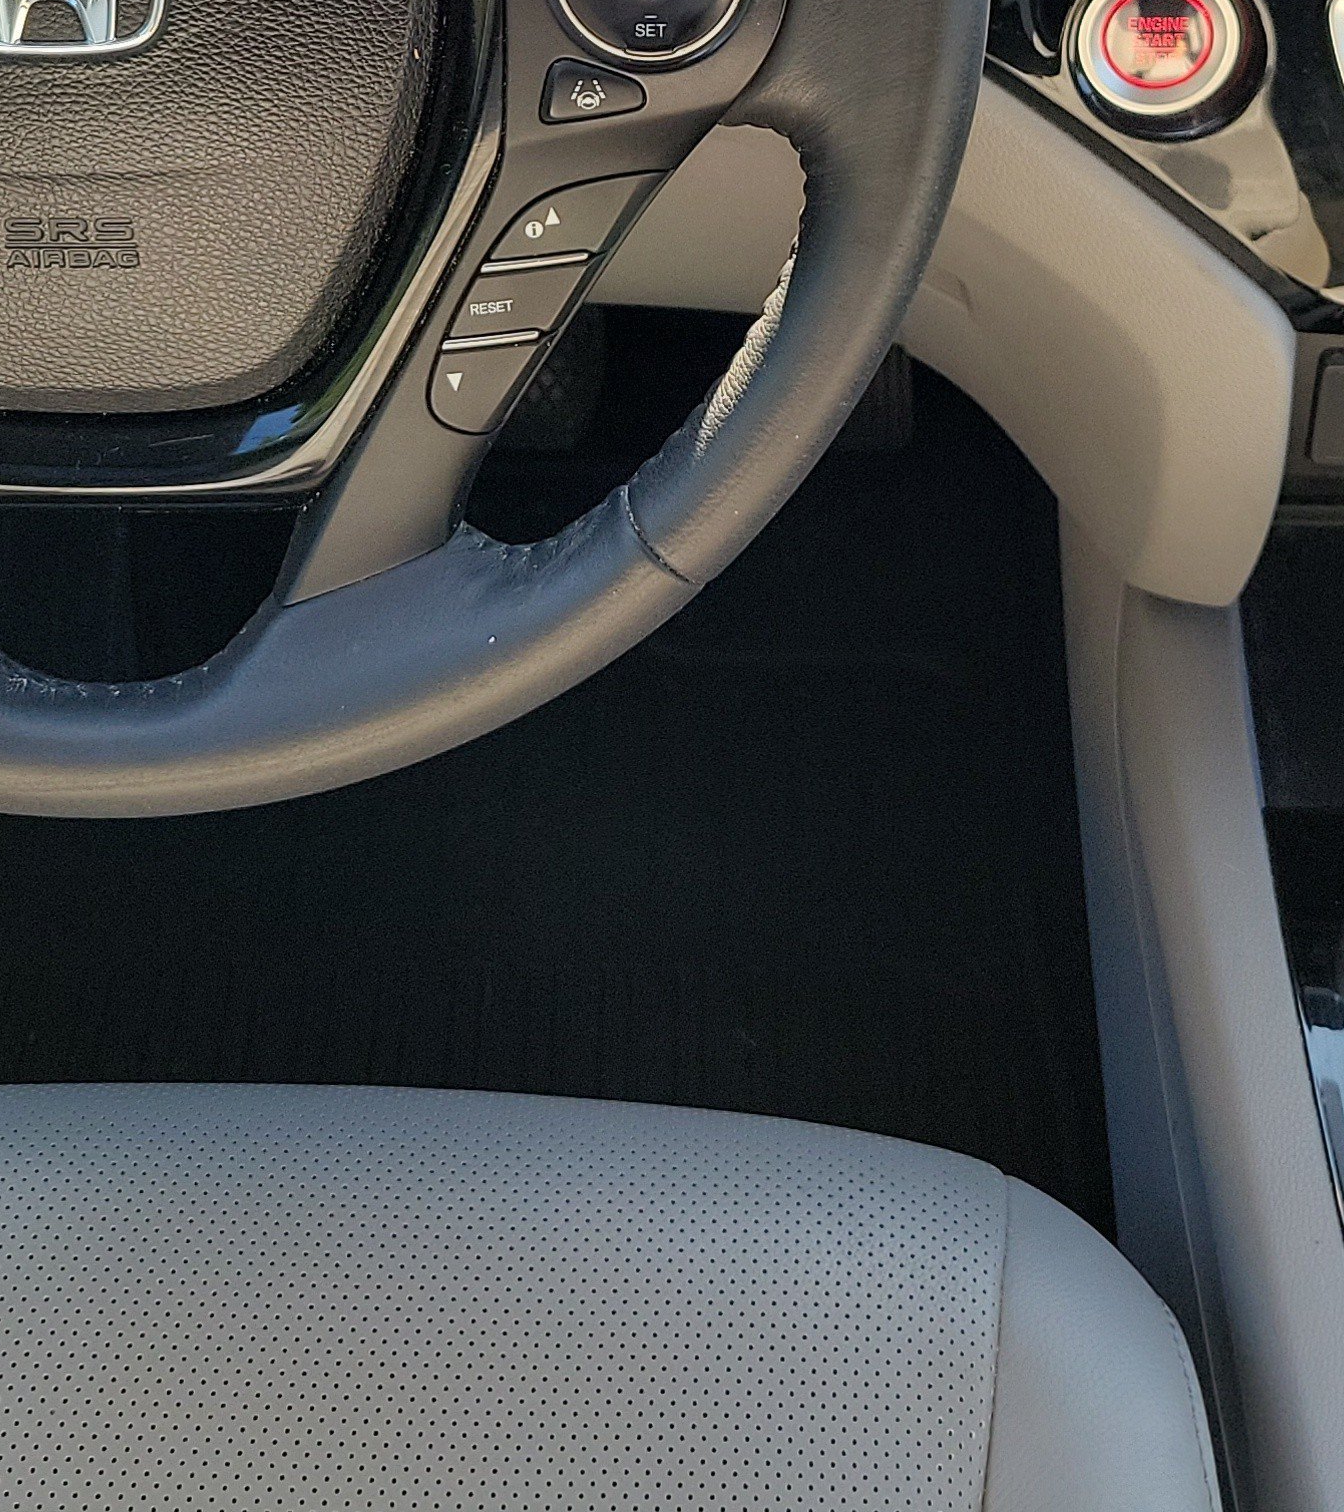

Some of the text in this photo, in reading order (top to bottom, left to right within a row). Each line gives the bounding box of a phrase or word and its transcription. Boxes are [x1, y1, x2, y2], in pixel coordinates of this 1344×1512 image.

[635, 23, 667, 38] SET
[1128, 17, 1190, 32] ENGINE
[6, 216, 136, 242] SRS
[7, 249, 141, 269] AIRBAG
[469, 299, 514, 316] RESET
